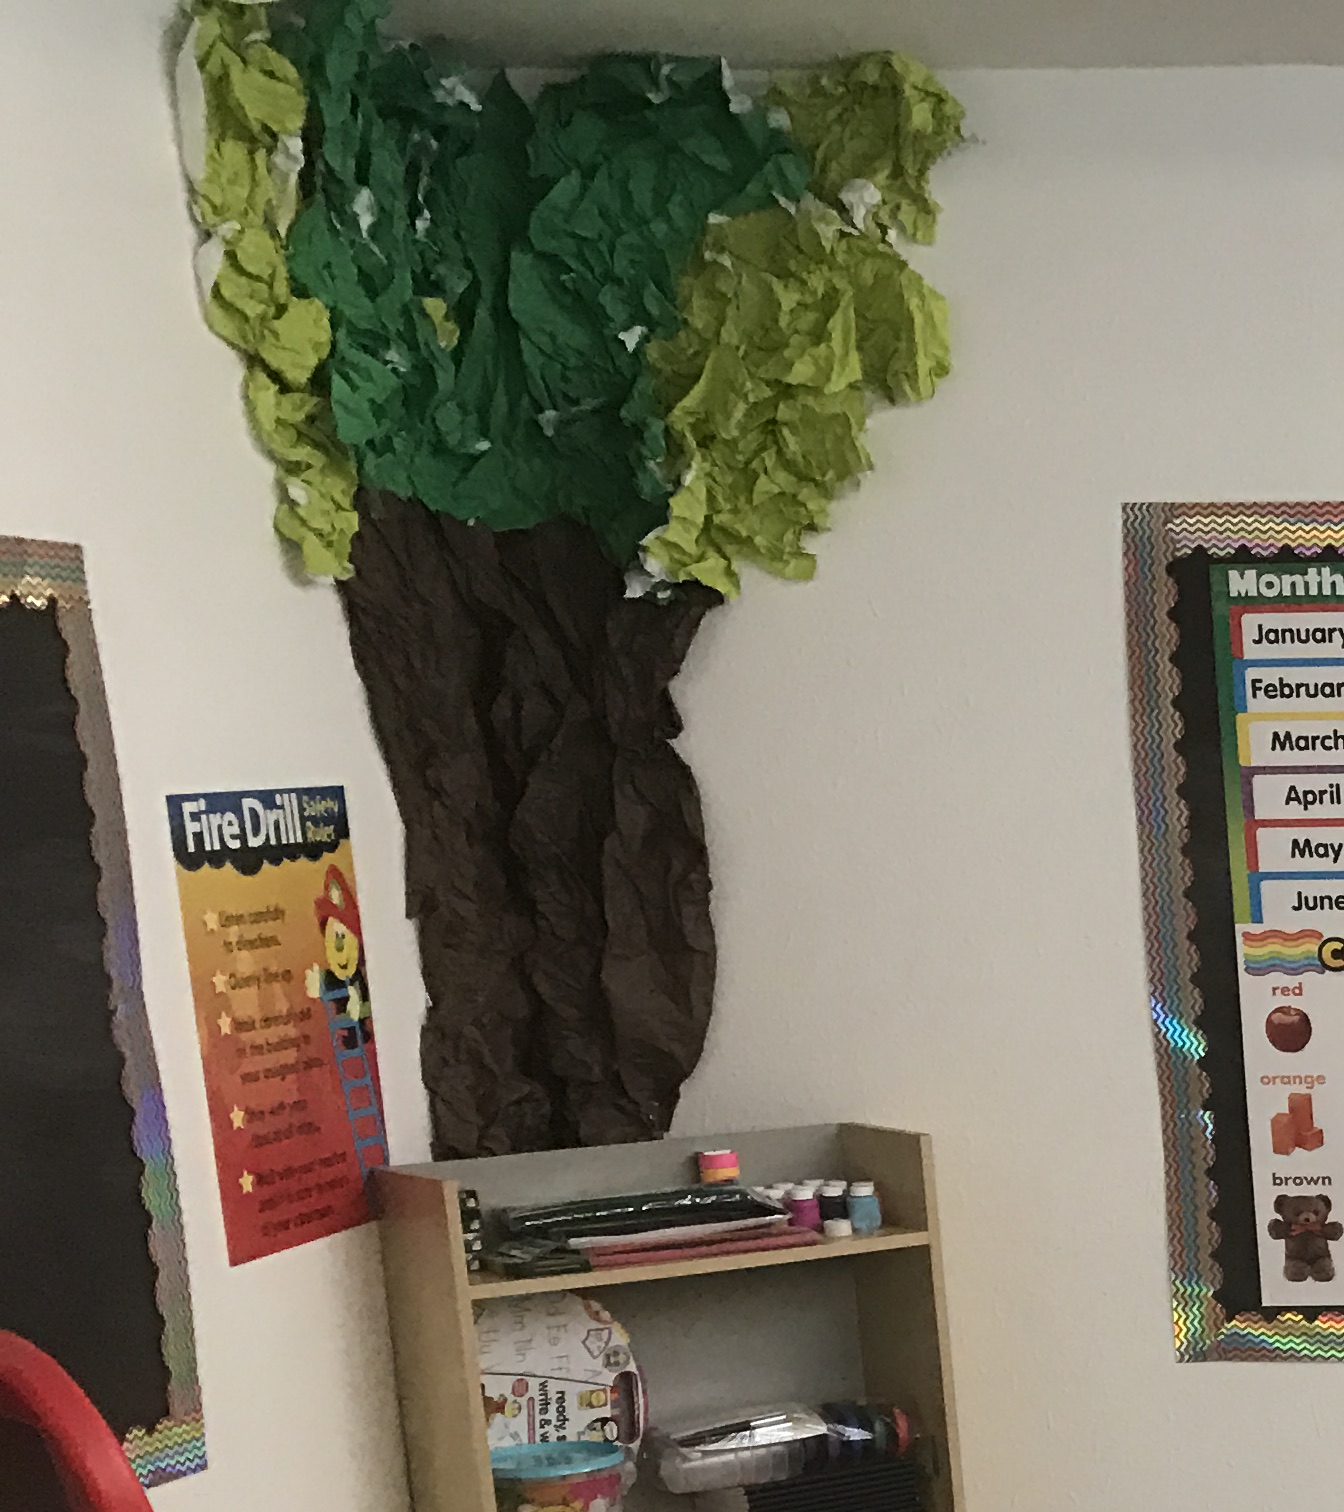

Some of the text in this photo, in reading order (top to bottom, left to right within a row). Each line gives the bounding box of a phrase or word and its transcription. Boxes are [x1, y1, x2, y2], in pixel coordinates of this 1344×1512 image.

[1285, 784, 1341, 810] April
[182, 793, 303, 853] Fire Drill
[1291, 839, 1343, 863] May
[1272, 981, 1303, 998] red
[1259, 1072, 1326, 1089] orange
[1272, 1172, 1332, 1188] brown
[539, 1380, 552, 1416] write
